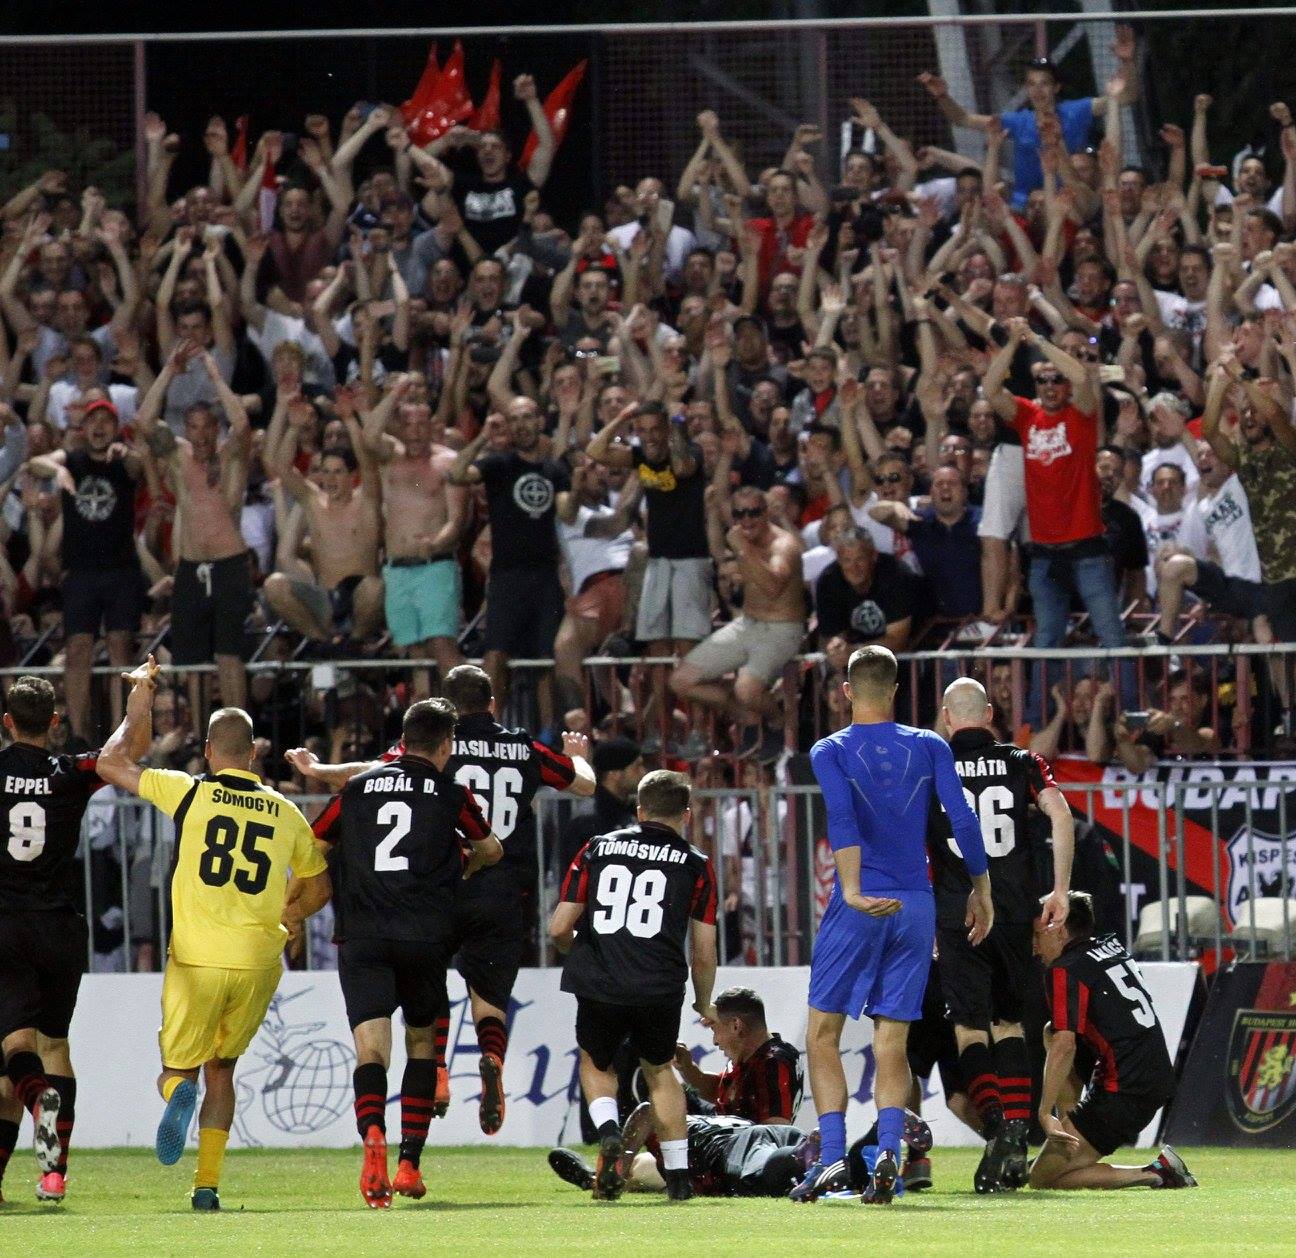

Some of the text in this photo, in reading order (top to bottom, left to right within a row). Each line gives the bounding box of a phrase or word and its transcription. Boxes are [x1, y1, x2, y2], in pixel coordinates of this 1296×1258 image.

[5, 775, 53, 795] EPPEL
[364, 774, 438, 796] BOBÁL D.
[954, 756, 1008, 777] ARÁTH
[7, 802, 46, 861] 8
[212, 789, 279, 818] SOMOGYI
[454, 764, 523, 840] 66
[199, 815, 275, 895] 85
[374, 801, 412, 871] 2
[593, 864, 667, 938] 98
